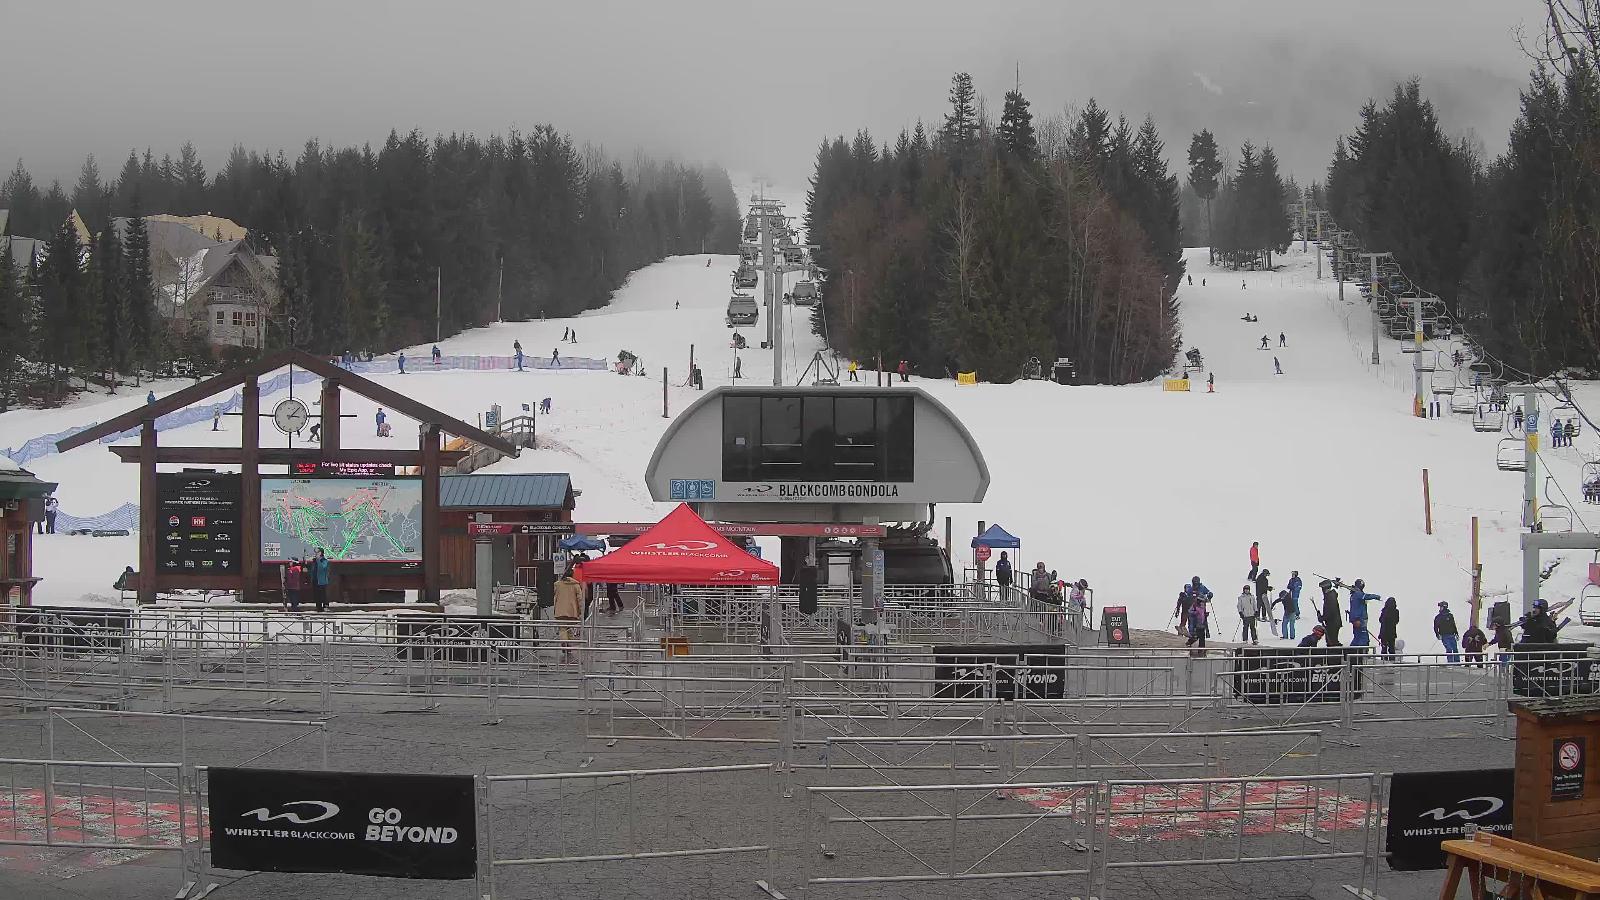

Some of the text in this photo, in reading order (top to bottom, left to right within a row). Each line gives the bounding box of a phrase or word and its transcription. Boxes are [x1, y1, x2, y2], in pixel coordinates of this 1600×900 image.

[780, 484, 898, 497] BLACKCOMB GONDOLA
[1312, 673, 1341, 682] BEYO
[368, 807, 402, 824] GO
[224, 827, 355, 840] WHISTLER BLACKCOMB
[365, 825, 458, 844] BEYOND
[1404, 827, 1459, 836] WHISTLER
